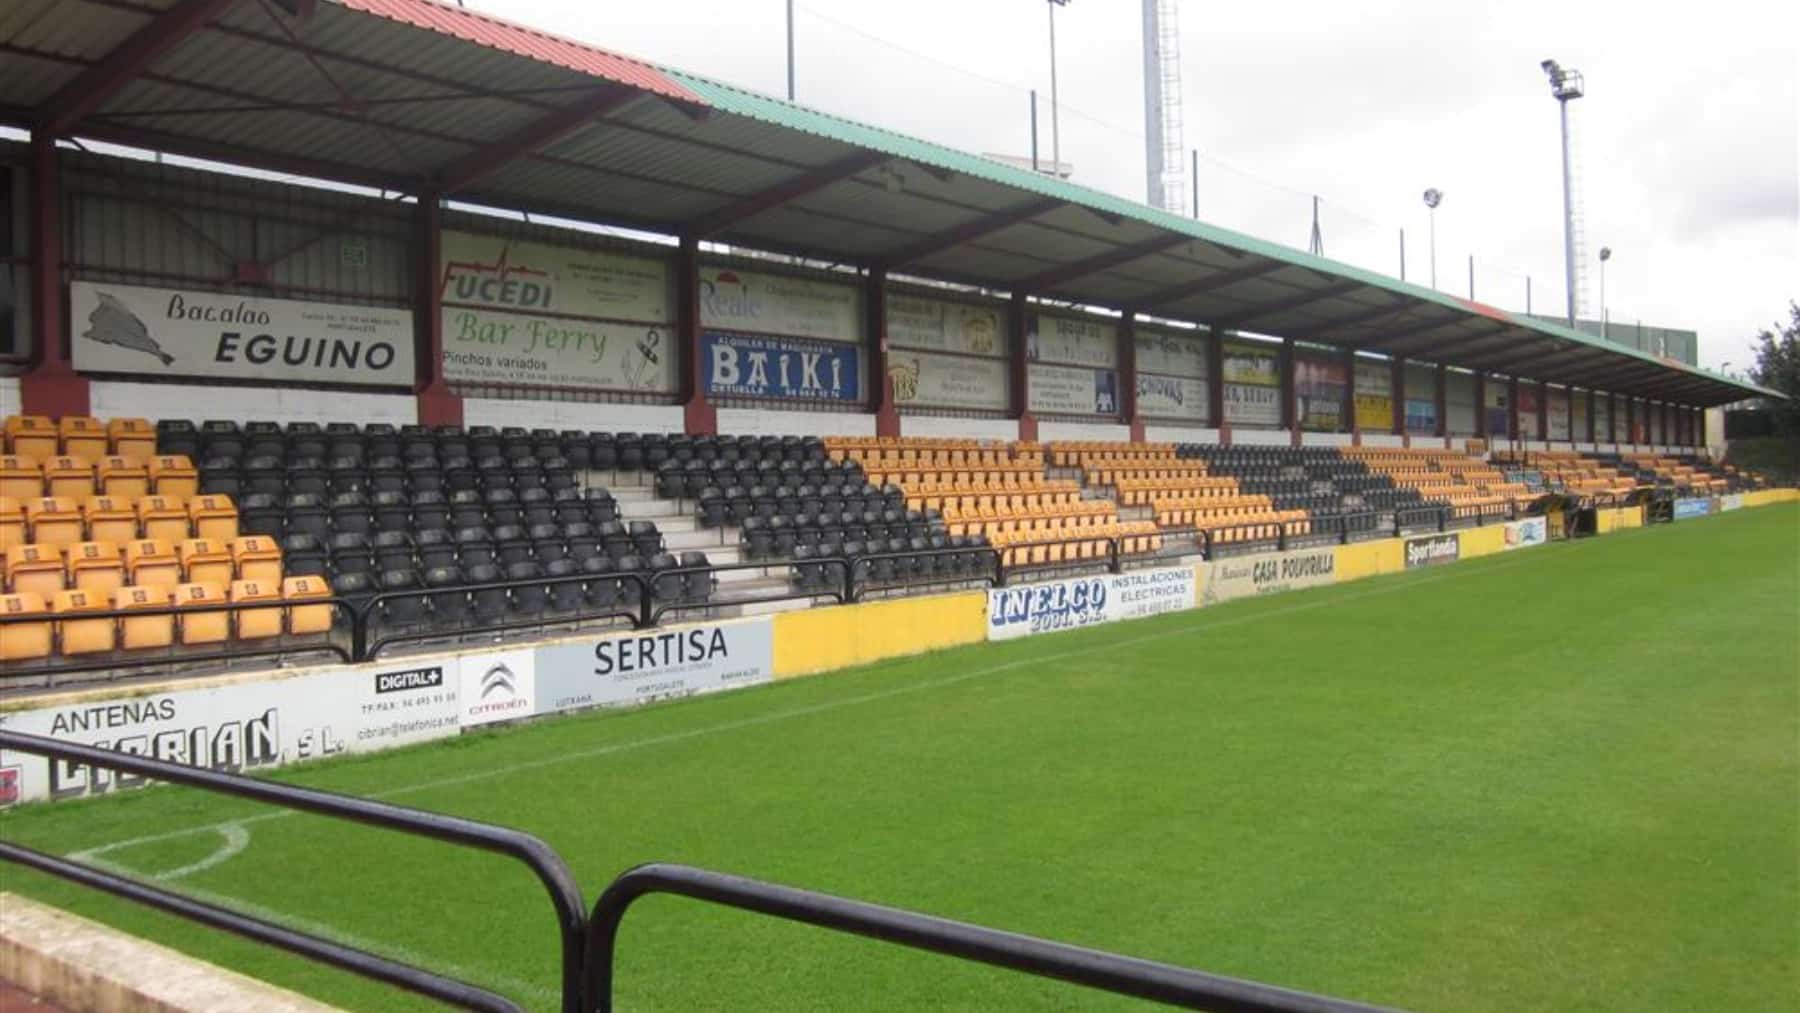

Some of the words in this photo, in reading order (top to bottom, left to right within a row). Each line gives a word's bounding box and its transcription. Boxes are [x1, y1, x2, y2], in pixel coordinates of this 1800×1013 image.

[166, 294, 270, 325] Bacalao
[215, 332, 395, 370] EGUINO
[456, 312, 514, 344] Bar
[524, 319, 606, 363] Ferry
[443, 351, 492, 366] Pinchos
[497, 356, 548, 370] variados
[1112, 570, 1193, 588] INSTALACIONES
[1253, 561, 1277, 584] CASA
[1281, 553, 1333, 579] POLVORILLA
[992, 579, 1106, 625] INELCO
[1121, 585, 1186, 602] ELECTRICAS
[595, 627, 728, 675] SERTISA
[379, 669, 440, 690] DIGITAL+
[51, 699, 176, 735] ANTENAS
